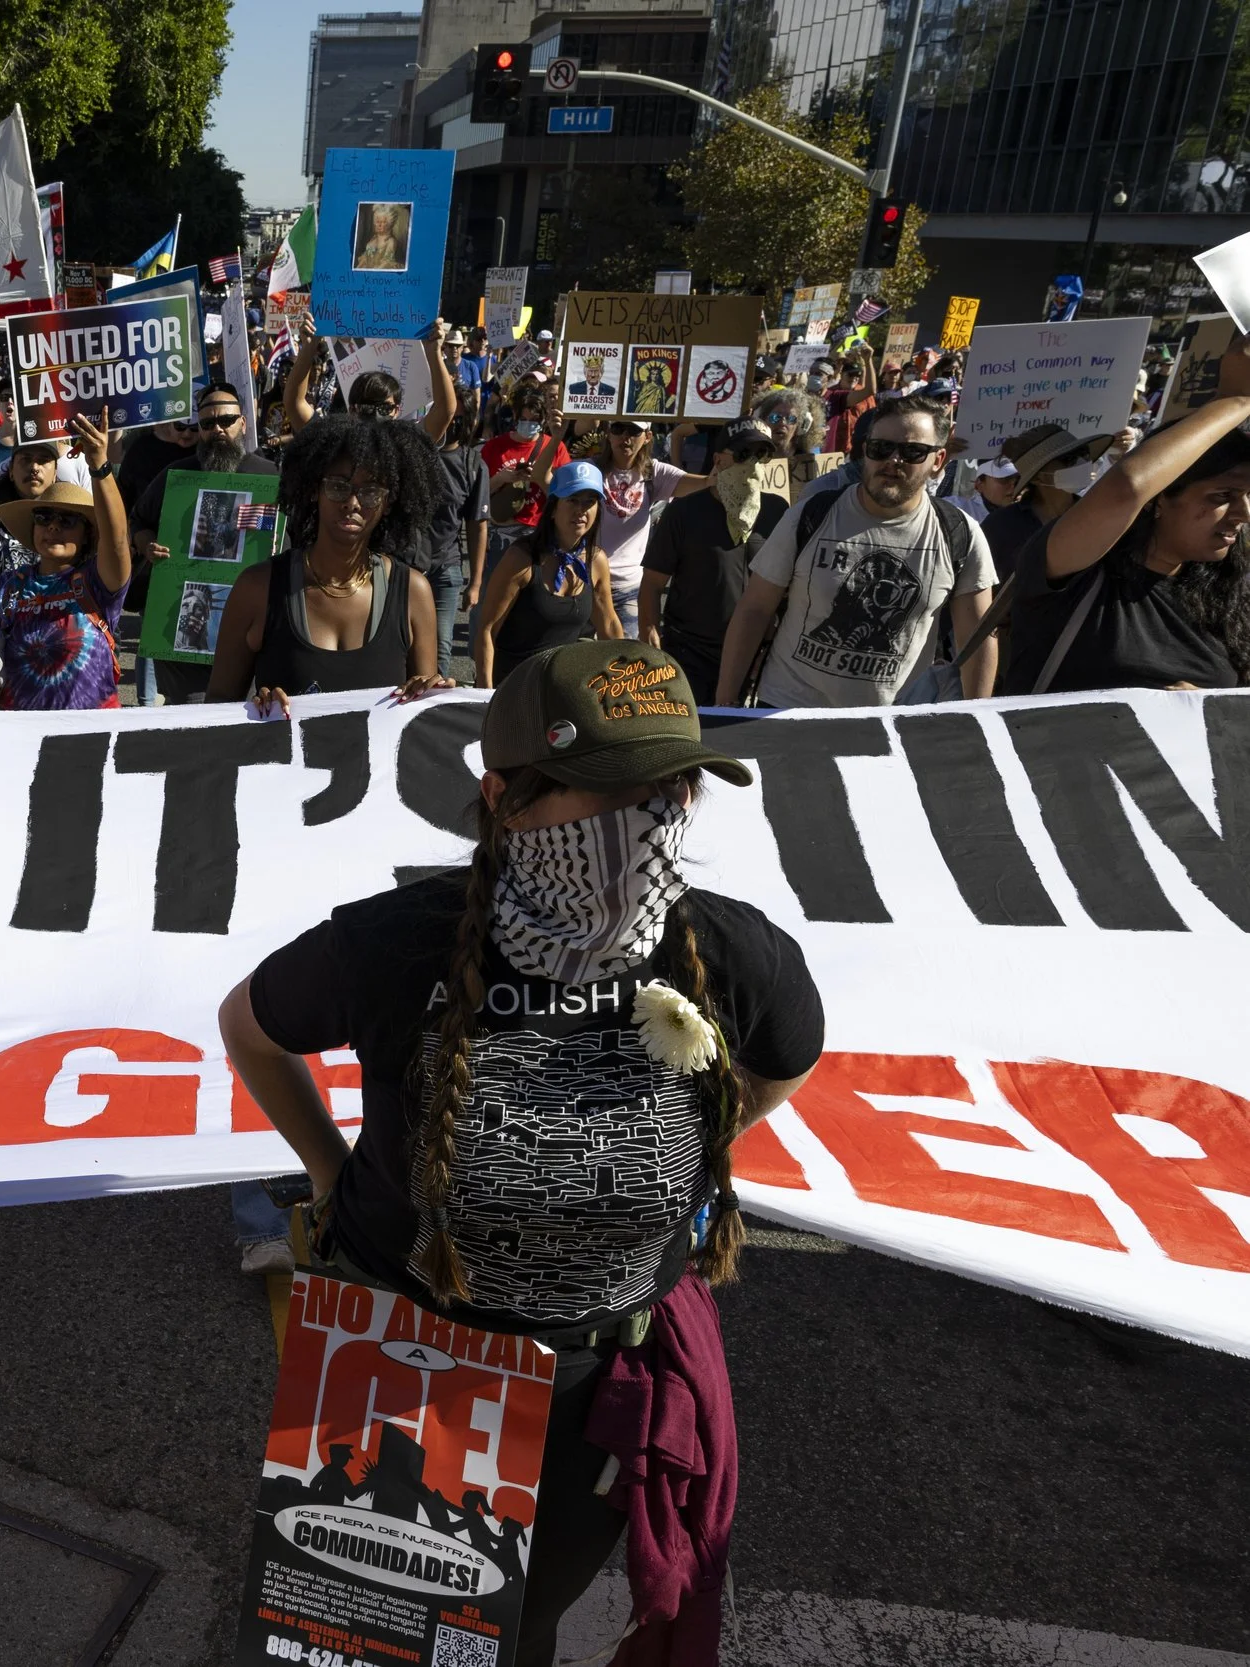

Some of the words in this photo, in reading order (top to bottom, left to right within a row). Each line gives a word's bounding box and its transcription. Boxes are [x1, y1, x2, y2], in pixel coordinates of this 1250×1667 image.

[563, 111, 599, 126] Hill
[375, 152, 426, 175] them
[350, 175, 379, 194] eat
[364, 273, 393, 285] know
[398, 274, 422, 285] what
[312, 300, 343, 321] While
[352, 300, 366, 321] he
[372, 302, 405, 323] builds
[410, 305, 427, 324] his
[574, 297, 629, 326] VETS
[634, 298, 719, 325] AGAINST
[949, 298, 977, 314] STOP
[335, 320, 400, 336] Ballroom
[625, 324, 693, 344] TRUMP
[945, 317, 970, 334] THE
[17, 324, 121, 369] UNITED
[127, 317, 183, 357] FOR
[1037, 330, 1068, 348] The
[573, 347, 586, 356] NO
[587, 347, 618, 358] KINGS
[637, 350, 650, 360] NO
[652, 349, 679, 360] KINGS
[340, 355, 362, 380] Real
[19, 371, 57, 407] LA
[58, 355, 184, 401] SCHOOLS
[978, 383, 1016, 400] people
[1022, 380, 1051, 398] give
[1054, 381, 1072, 398] up
[1079, 376, 1110, 390] their
[568, 395, 579, 403] NO
[580, 396, 614, 404] FASCISTS
[990, 417, 1004, 434] by
[1008, 414, 1070, 431] thinking
[1078, 412, 1103, 426] they
[762, 464, 786, 489] NO
[816, 548, 849, 571] LA
[798, 639, 836, 667] RIOT
[837, 652, 898, 677] SQUAD
[588, 663, 676, 701] Fernando
[607, 660, 646, 681] San
[630, 690, 666, 702] VALLEY
[604, 704, 632, 720] LOS
[638, 702, 689, 717] ANGELES
[426, 981, 621, 1016] AOLISH
[405, 1347, 429, 1364] A
[323, 1514, 375, 1532] FUERA
[379, 1526, 400, 1538] DE
[402, 1532, 485, 1566] NUESTRAS
[293, 1521, 481, 1595] COMUNIDADES!
[266, 1560, 279, 1571] ICE
[280, 1565, 290, 1574] no
[291, 1567, 315, 1581] puede
[316, 1571, 346, 1590] ingresar
[353, 1584, 361, 1593] tu
[362, 1585, 385, 1603] hogar
[386, 1591, 429, 1613] legalmente
[274, 1572, 284, 1581] no
[287, 1574, 309, 1588] tienen
[311, 1580, 326, 1590] una
[328, 1582, 350, 1598] orden
[352, 1589, 379, 1608] judicial
[382, 1597, 410, 1616] firmada
[413, 1608, 427, 1622] por
[262, 1587, 283, 1600] orden
[285, 1591, 329, 1613] equivocada,
[338, 1607, 353, 1618] una
[354, 1611, 376, 1626] orden
[377, 1619, 387, 1627] no
[389, 1620, 424, 1639] completa
[274, 1580, 291, 1593] juez.
[293, 1585, 303, 1594] Es
[304, 1587, 329, 1602] común
[331, 1595, 345, 1607] que
[359, 1603, 389, 1620] agentes
[391, 1611, 417, 1628] tengan
[284, 1602, 299, 1614] que
[300, 1606, 322, 1620] tienen
[323, 1612, 350, 1626] alguna.
[462, 1604, 481, 1619] SEA
[440, 1609, 500, 1636] VOLUNTARIO
[284, 1613, 296, 1626] DE
[298, 1616, 350, 1643] ASISTENCIA
[352, 1632, 363, 1646] AL
[365, 1638, 420, 1663] INMIGRANTE
[309, 1632, 320, 1644] EN
[322, 1636, 333, 1648] LA
